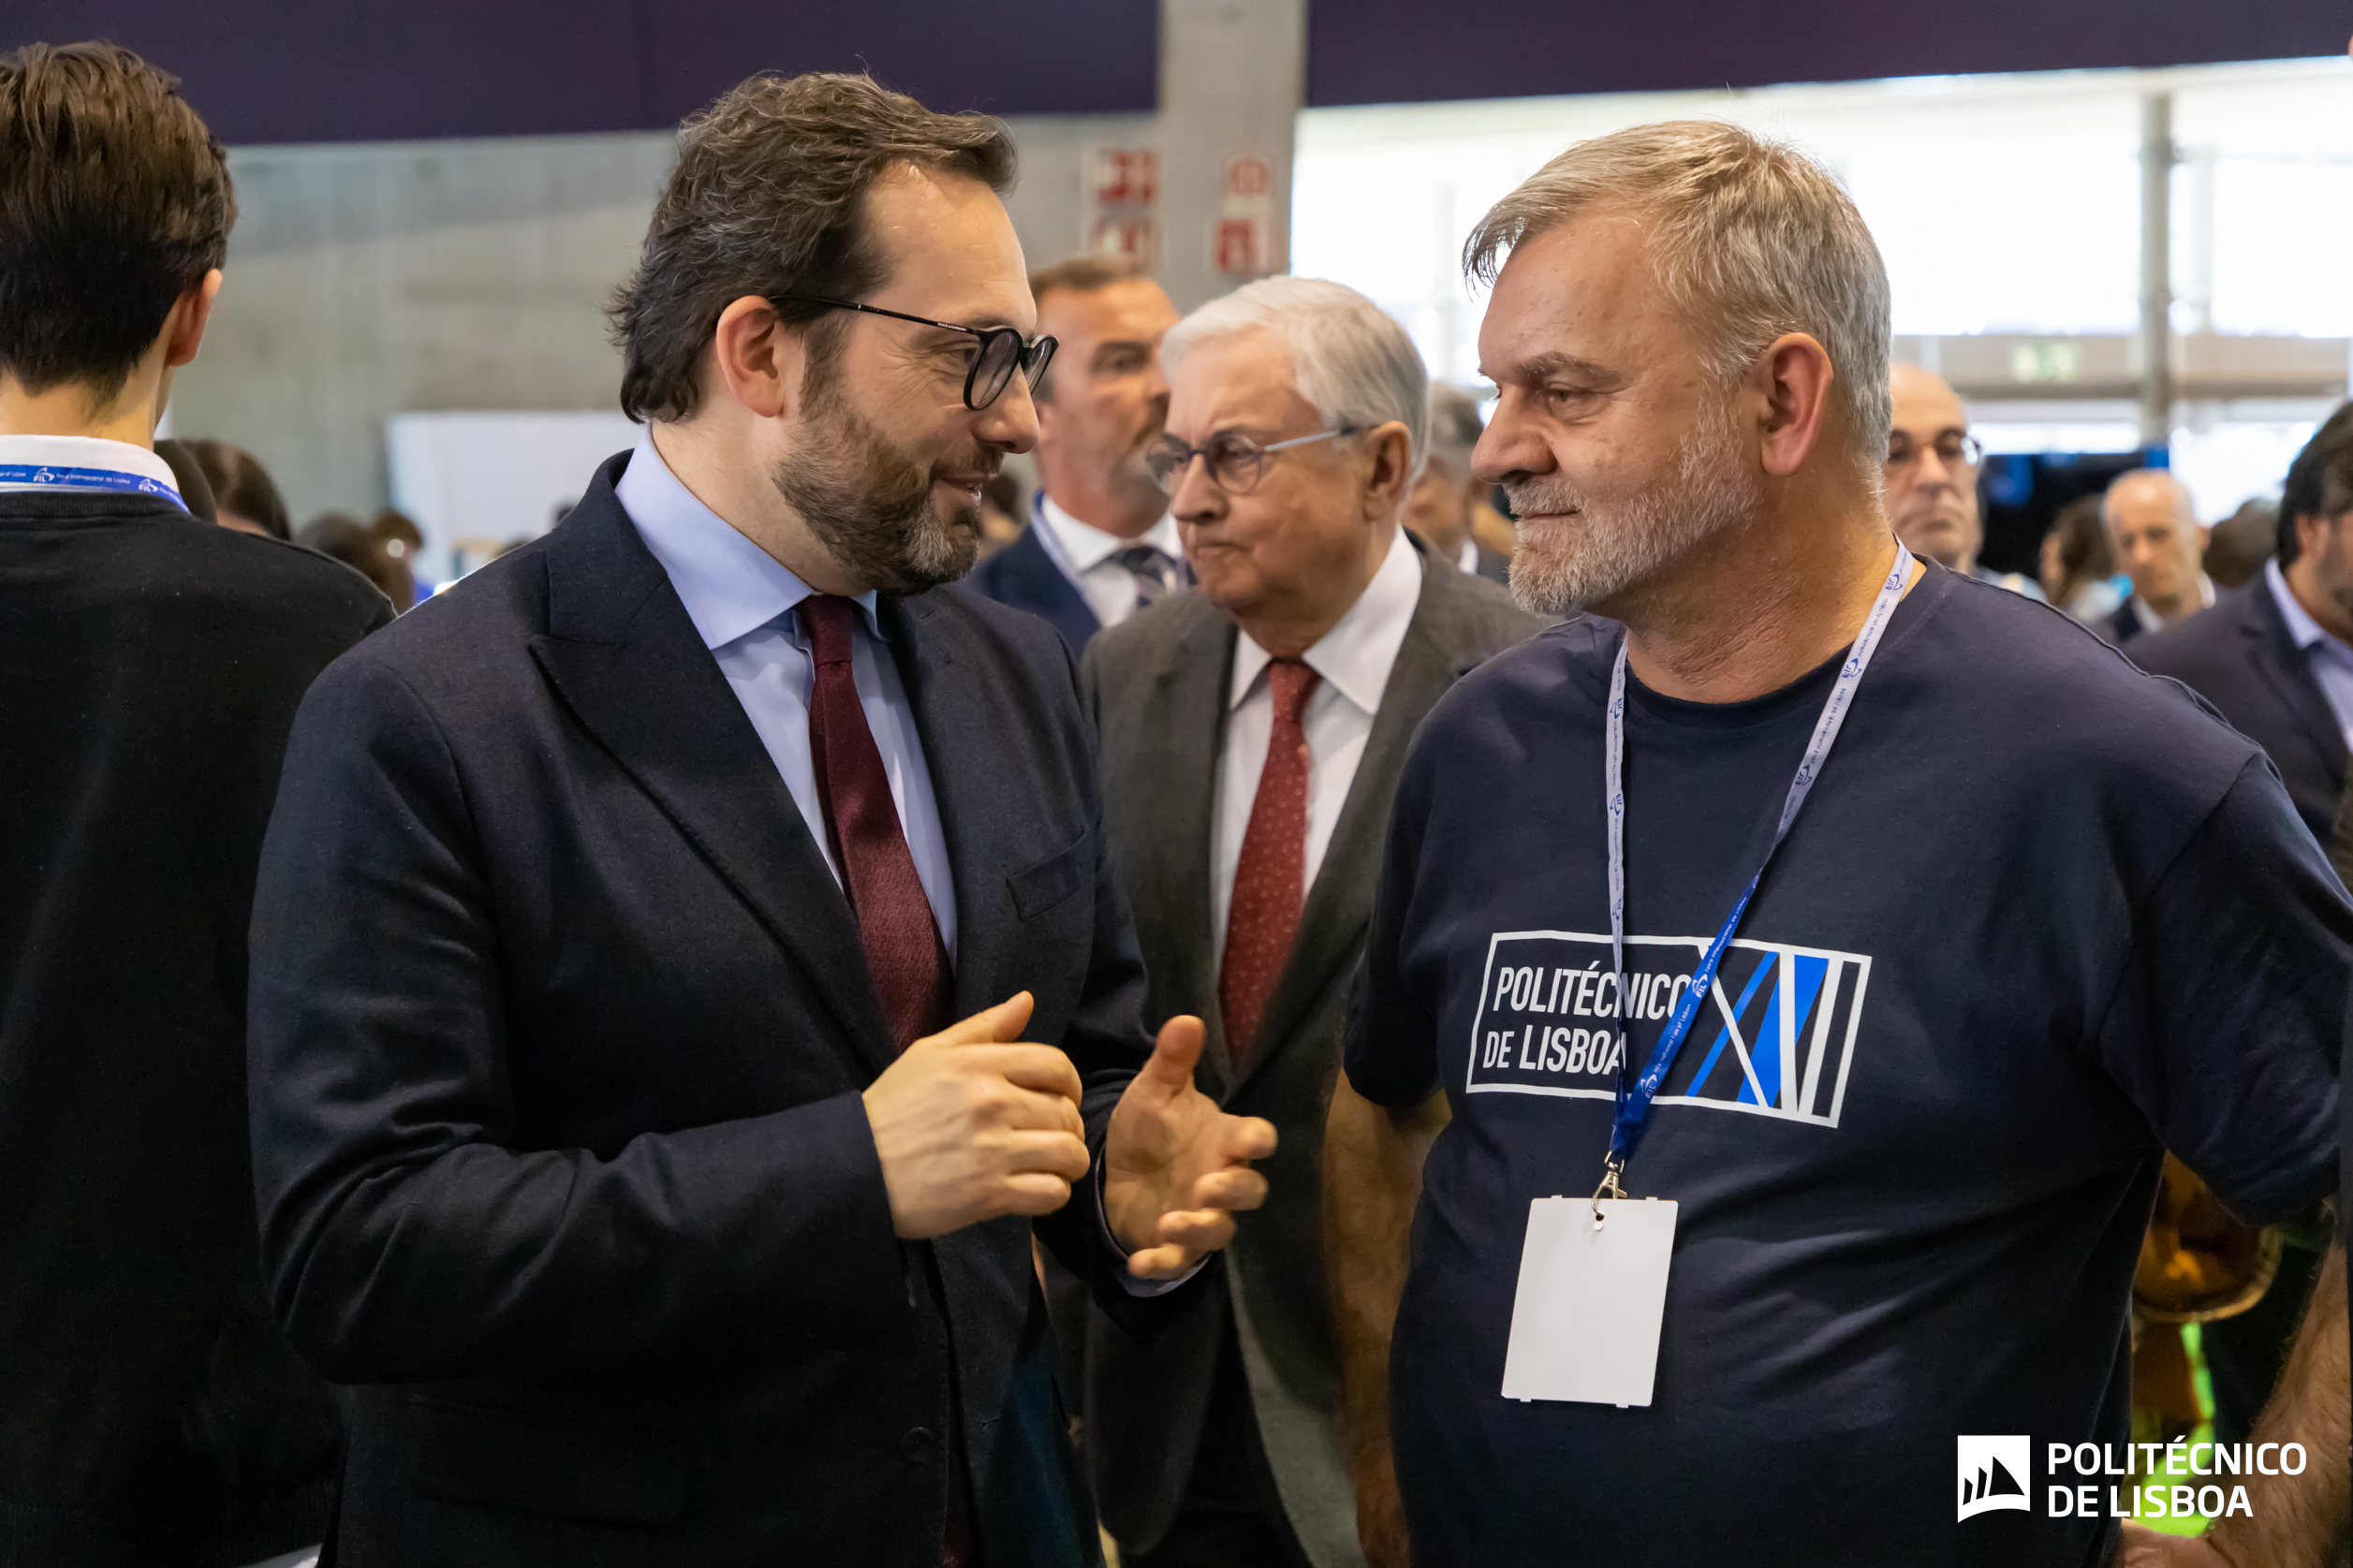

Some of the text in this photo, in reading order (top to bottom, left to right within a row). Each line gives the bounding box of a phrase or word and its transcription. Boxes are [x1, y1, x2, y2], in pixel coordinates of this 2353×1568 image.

[1493, 960, 1692, 1020] POLITÉCNICO
[1483, 1024, 1627, 1076] DE LISBOA
